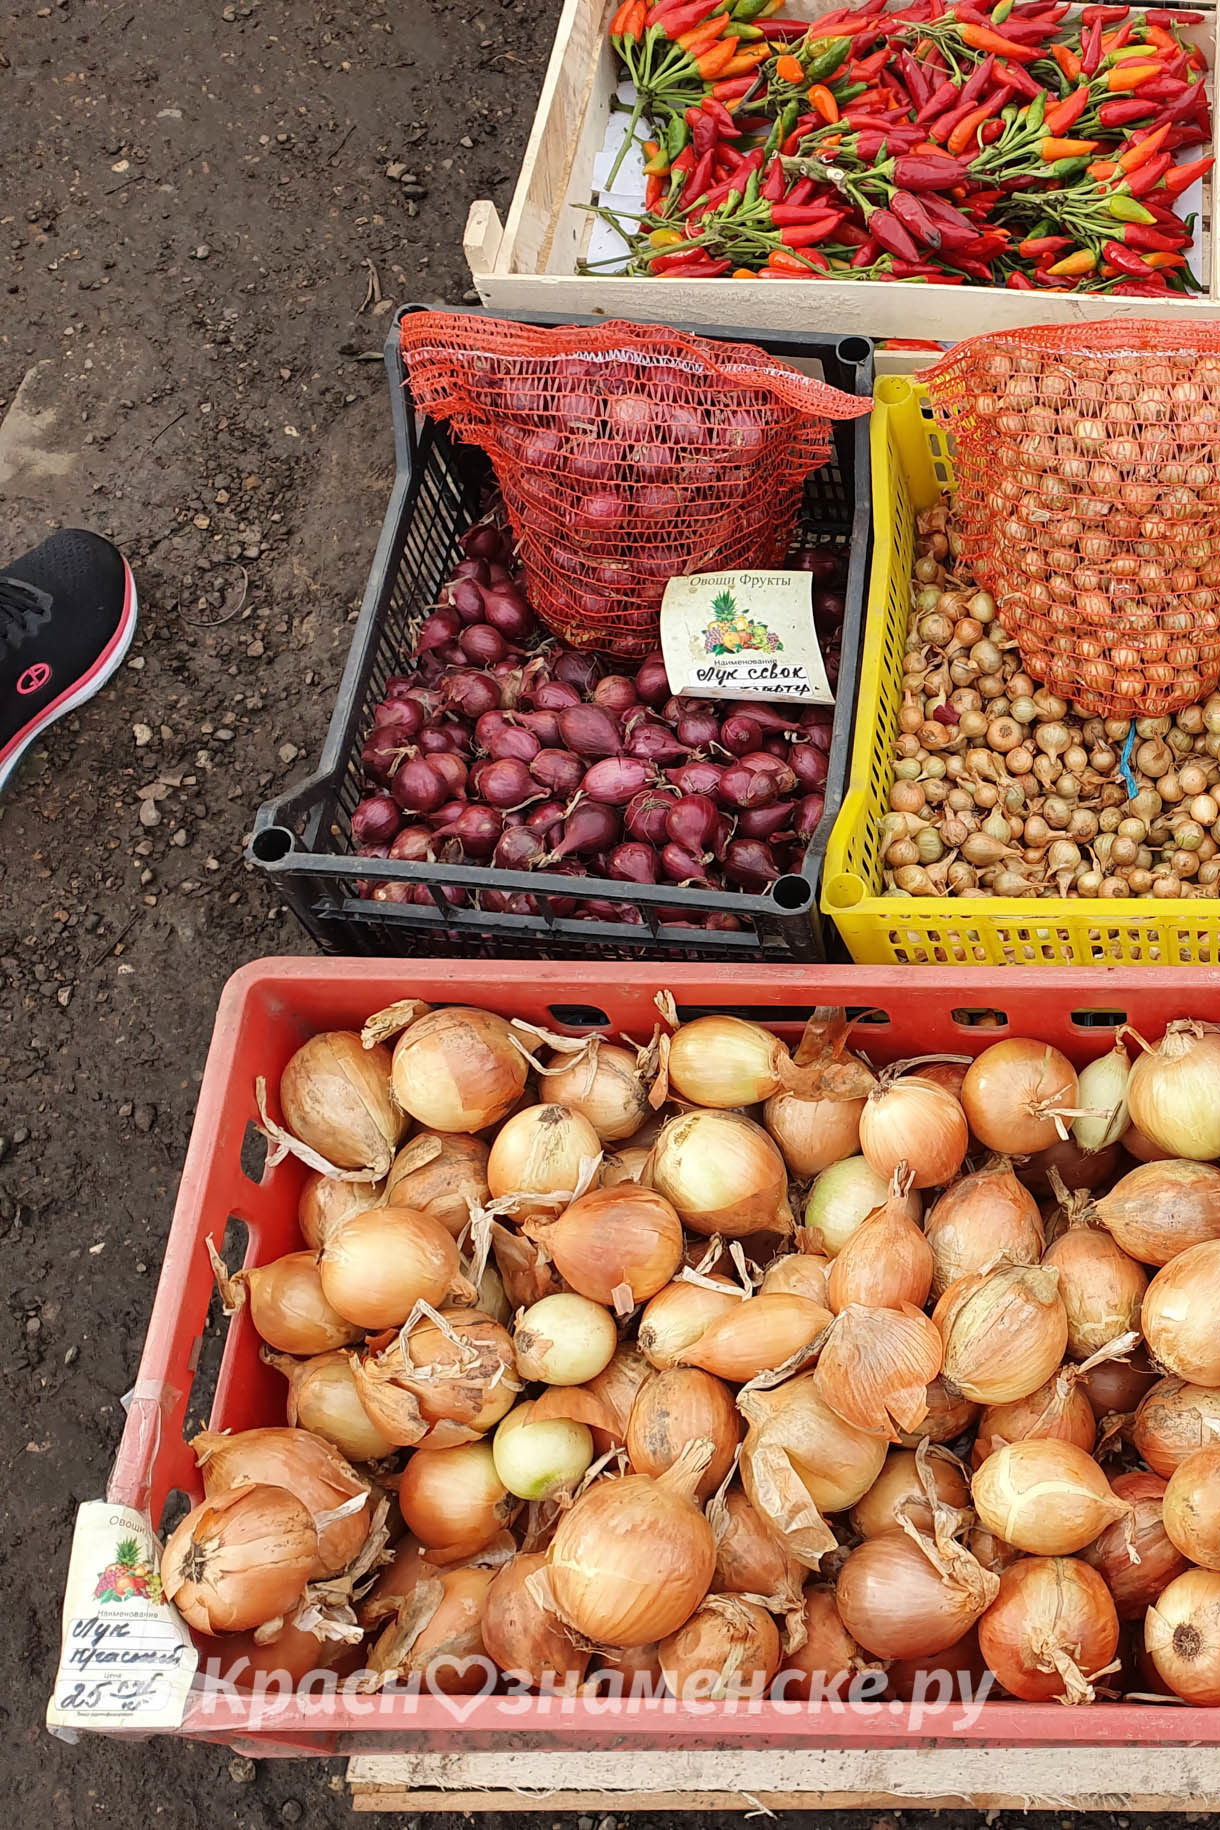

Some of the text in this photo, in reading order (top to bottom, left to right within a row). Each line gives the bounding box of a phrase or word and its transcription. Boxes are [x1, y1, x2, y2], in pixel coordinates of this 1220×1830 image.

[689, 574, 791, 588] Овощи Фрукты
[109, 1515, 145, 1534] Овощи
